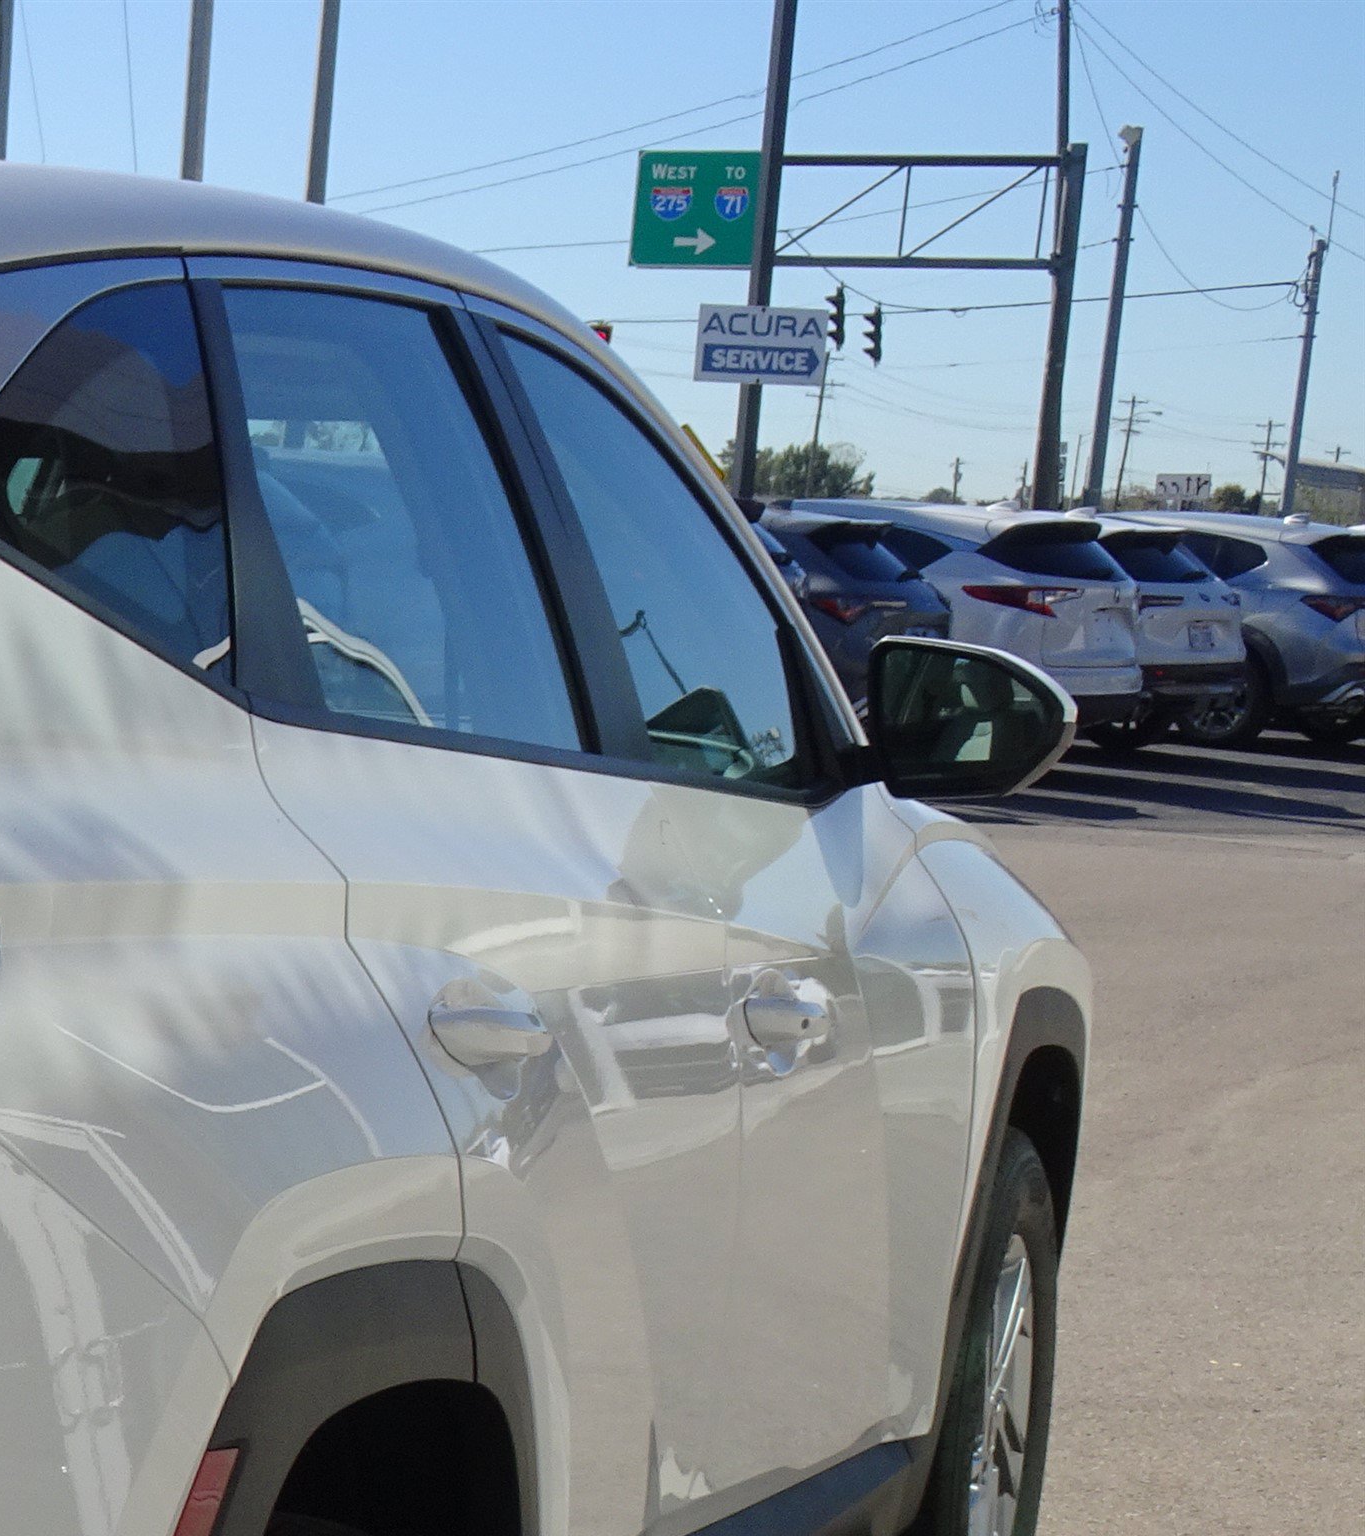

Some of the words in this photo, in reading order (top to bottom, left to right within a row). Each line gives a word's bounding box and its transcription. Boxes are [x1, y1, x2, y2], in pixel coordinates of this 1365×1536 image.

[652, 163, 698, 180] WEST
[725, 166, 746, 180] TO
[654, 195, 688, 212] 275
[723, 195, 742, 214] 71
[702, 312, 823, 339] ACURA
[711, 350, 810, 372] SERVICE
